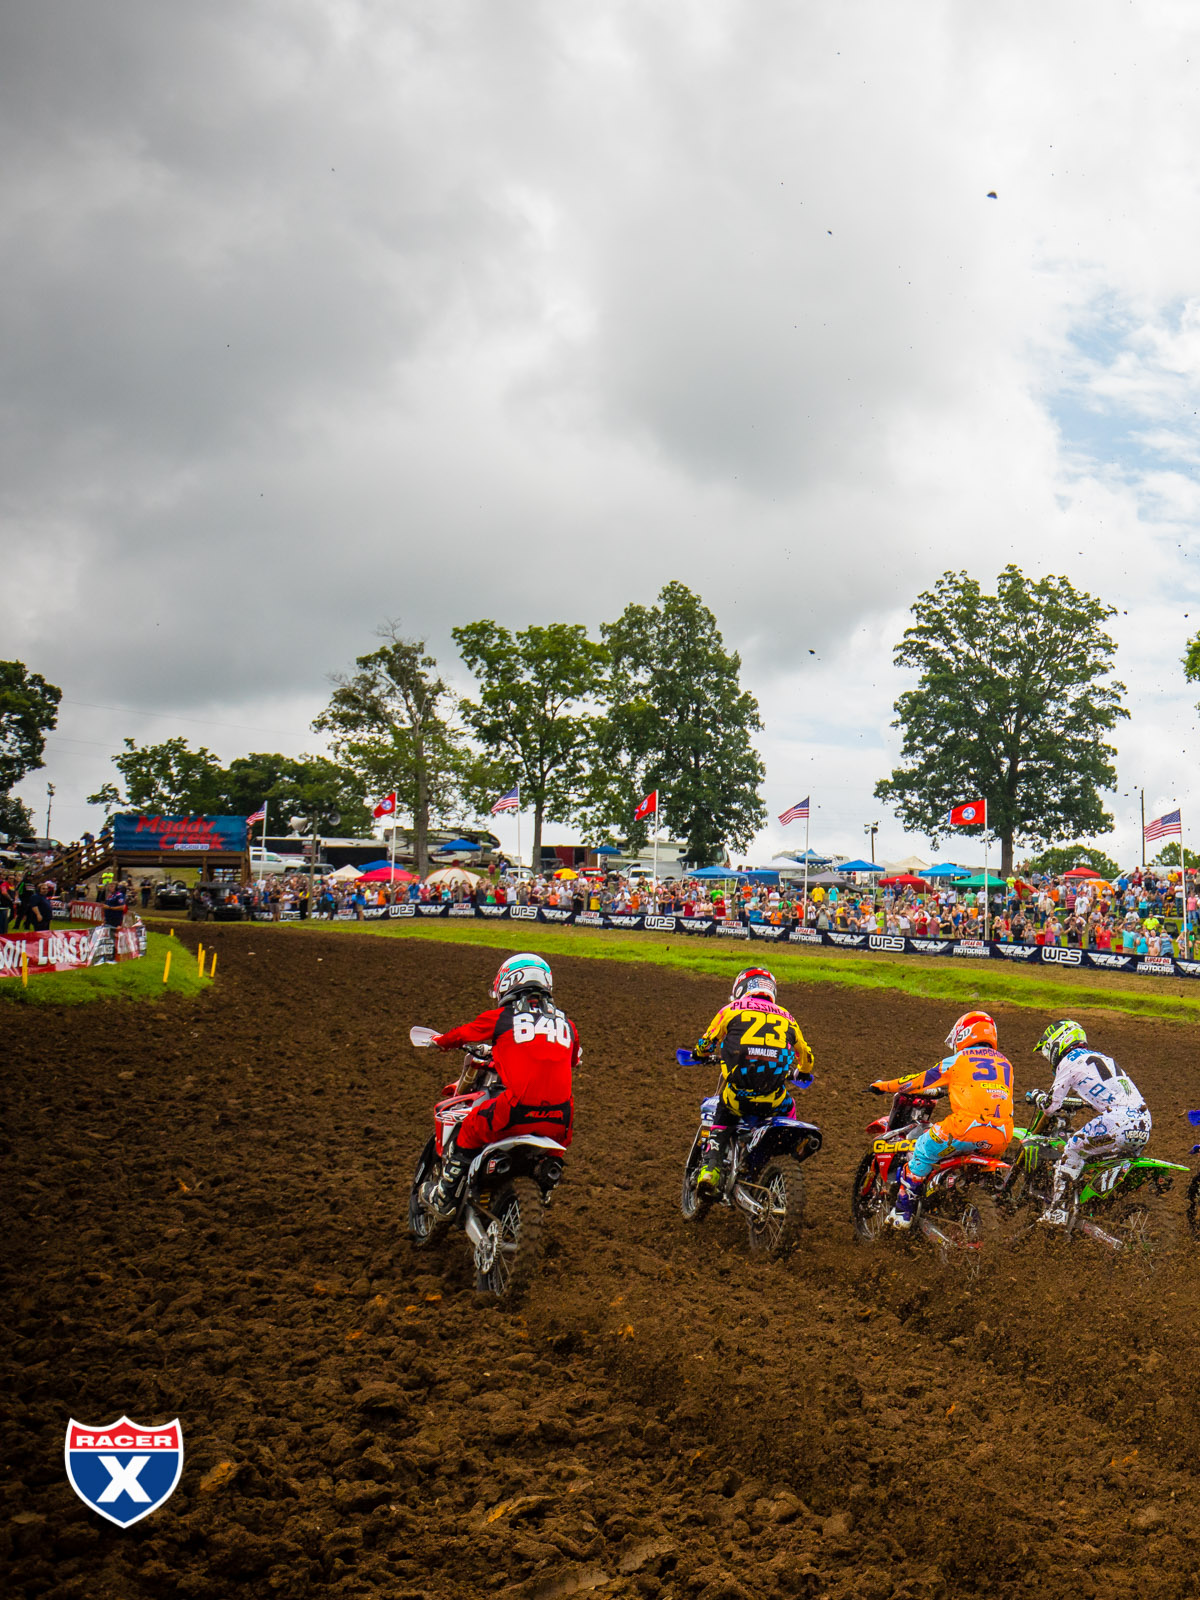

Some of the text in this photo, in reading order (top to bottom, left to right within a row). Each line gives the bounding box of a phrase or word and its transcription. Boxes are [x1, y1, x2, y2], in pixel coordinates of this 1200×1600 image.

[135, 816, 217, 833] Muddy
[158, 832, 226, 850] Creek
[71, 903, 92, 920] LUCAS
[389, 904, 415, 917] WPS
[510, 905, 538, 919] WPS
[644, 915, 676, 931] WPS
[38, 936, 77, 965] LUCAS
[868, 934, 906, 952] WPS
[1041, 945, 1082, 965] WPS
[513, 1012, 571, 1049] 640
[740, 1010, 789, 1049] 23
[747, 1047, 779, 1058] YAMALUBE
[968, 1057, 1011, 1088] 31
[980, 1082, 1011, 1095] GEICO
[1077, 1077, 1116, 1105] FOX
